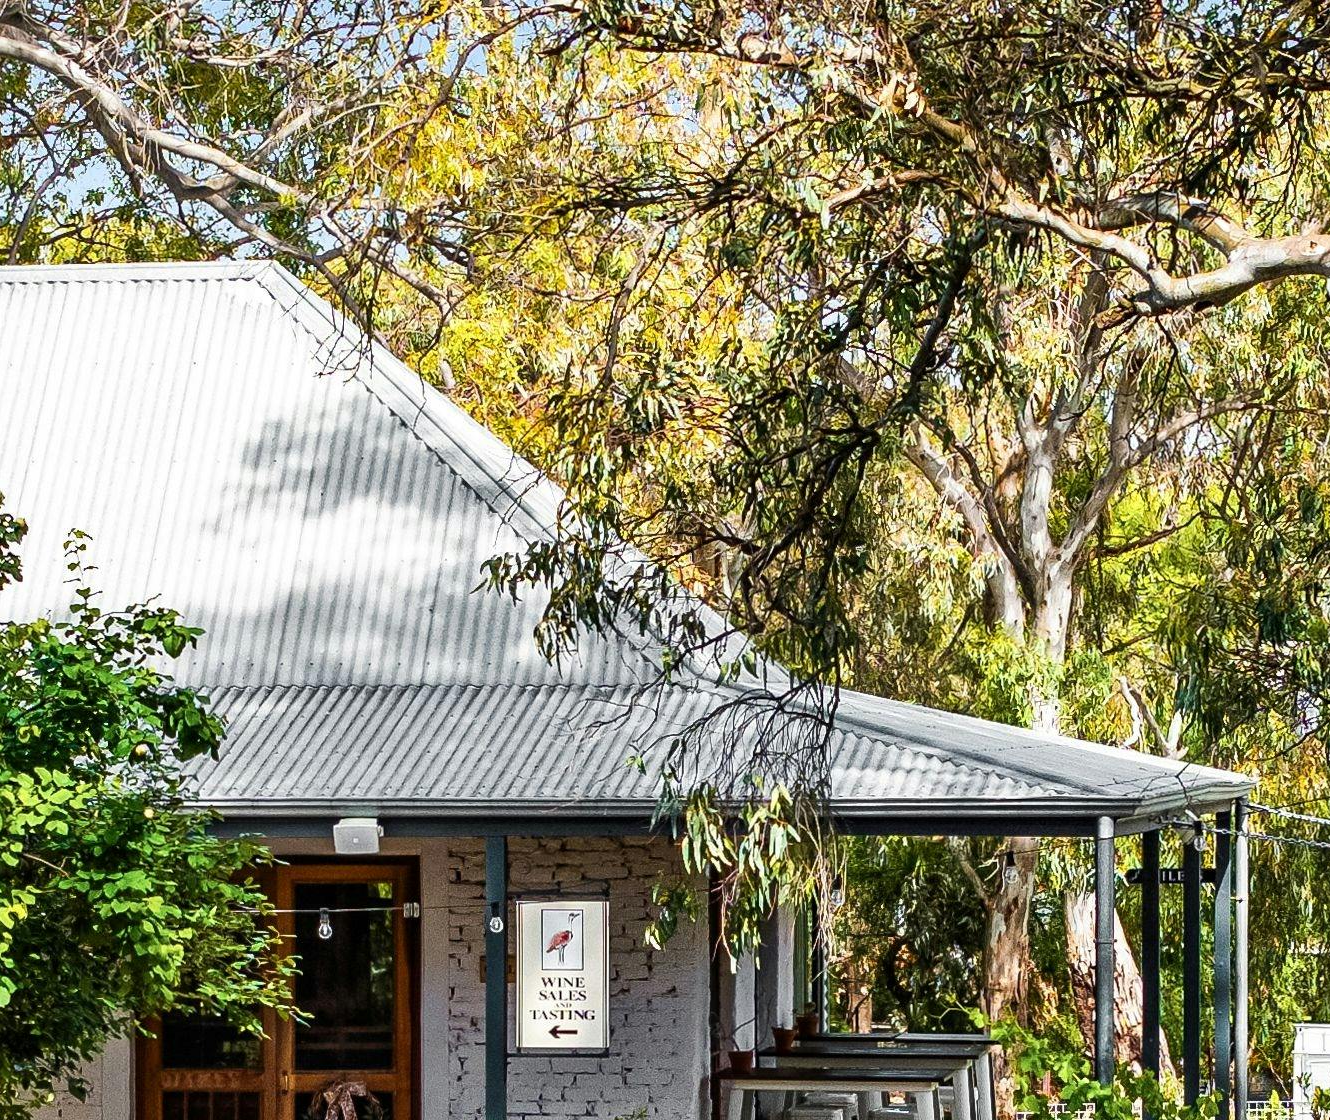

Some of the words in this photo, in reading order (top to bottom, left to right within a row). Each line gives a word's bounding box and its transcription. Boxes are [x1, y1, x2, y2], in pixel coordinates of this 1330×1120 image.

[541, 977, 586, 988] WINE
[538, 990, 587, 1001] SALES
[529, 1010, 595, 1020] TASTING
